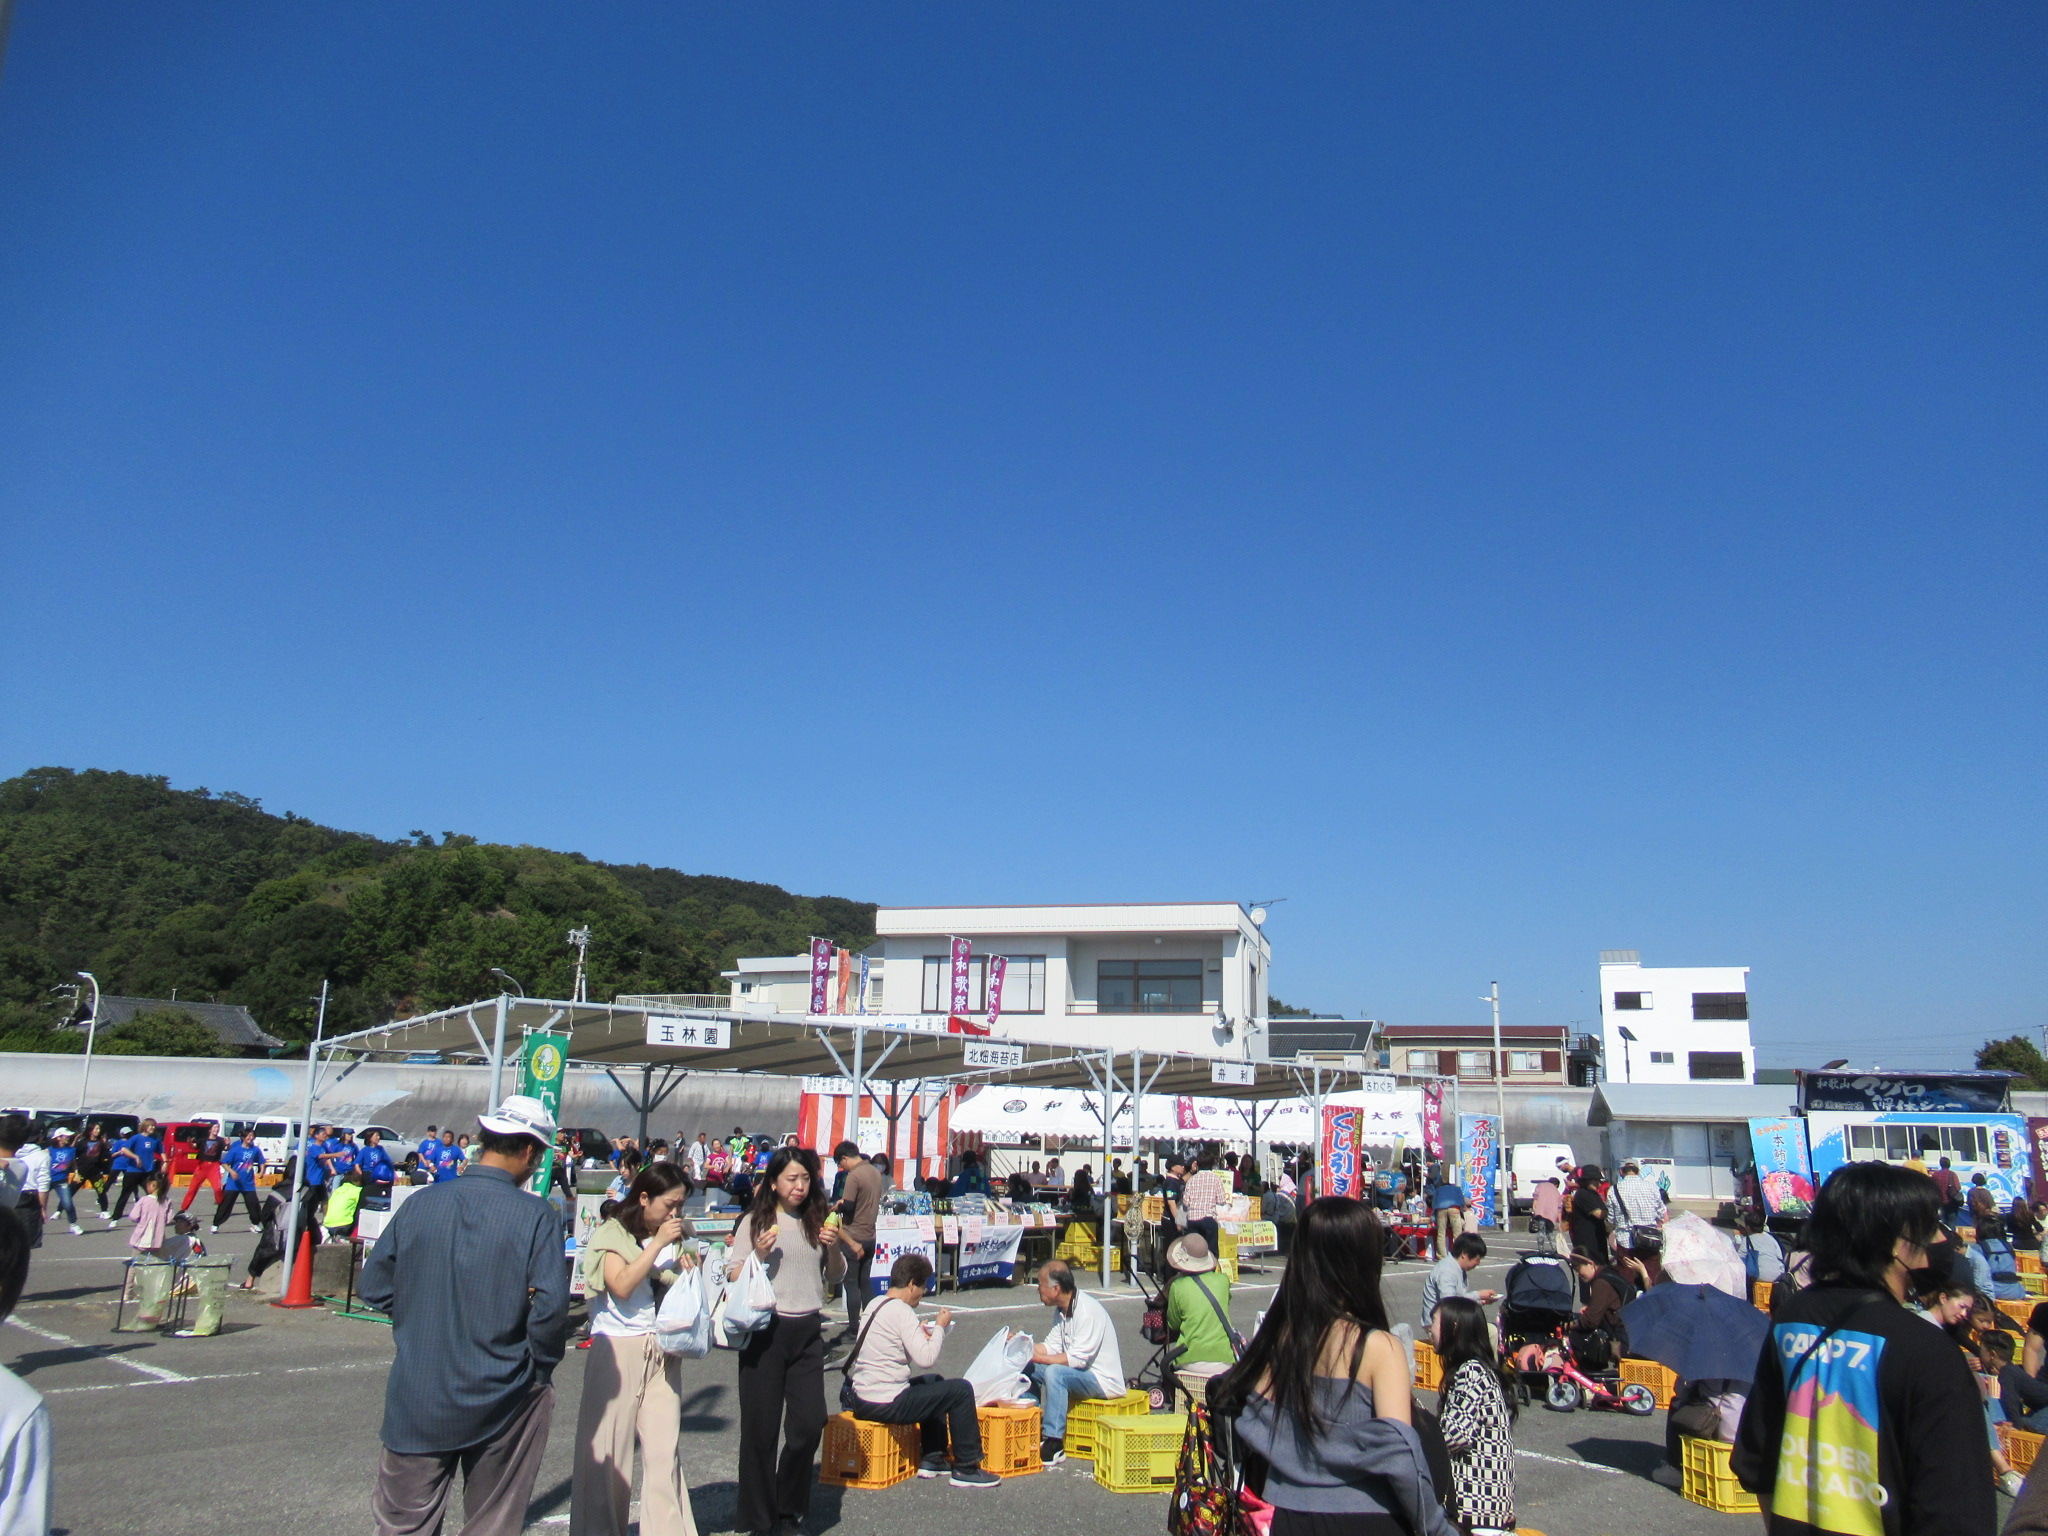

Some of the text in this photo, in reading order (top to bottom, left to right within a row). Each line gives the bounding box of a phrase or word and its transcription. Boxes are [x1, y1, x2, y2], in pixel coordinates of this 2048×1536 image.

[953, 957, 968, 1013] 和歌祭
[987, 972, 1000, 1020] 和歌祭
[660, 1025, 719, 1045] 玉林園
[968, 1048, 1020, 1066] 北畑海苔店
[1366, 1081, 1393, 1092] さわぐち
[1816, 1076, 1926, 1097] 和歌山 マグロ
[984, 1134, 1019, 1143] 和歌山放送
[1425, 1098, 1442, 1154] 和歌祭
[1331, 1111, 1355, 1196] くじ引き
[1470, 1119, 1491, 1219] スーパーボールすくい
[1772, 1134, 1793, 1202] 本鮪三味丼
[1781, 1332, 1872, 1369] CAMP7
